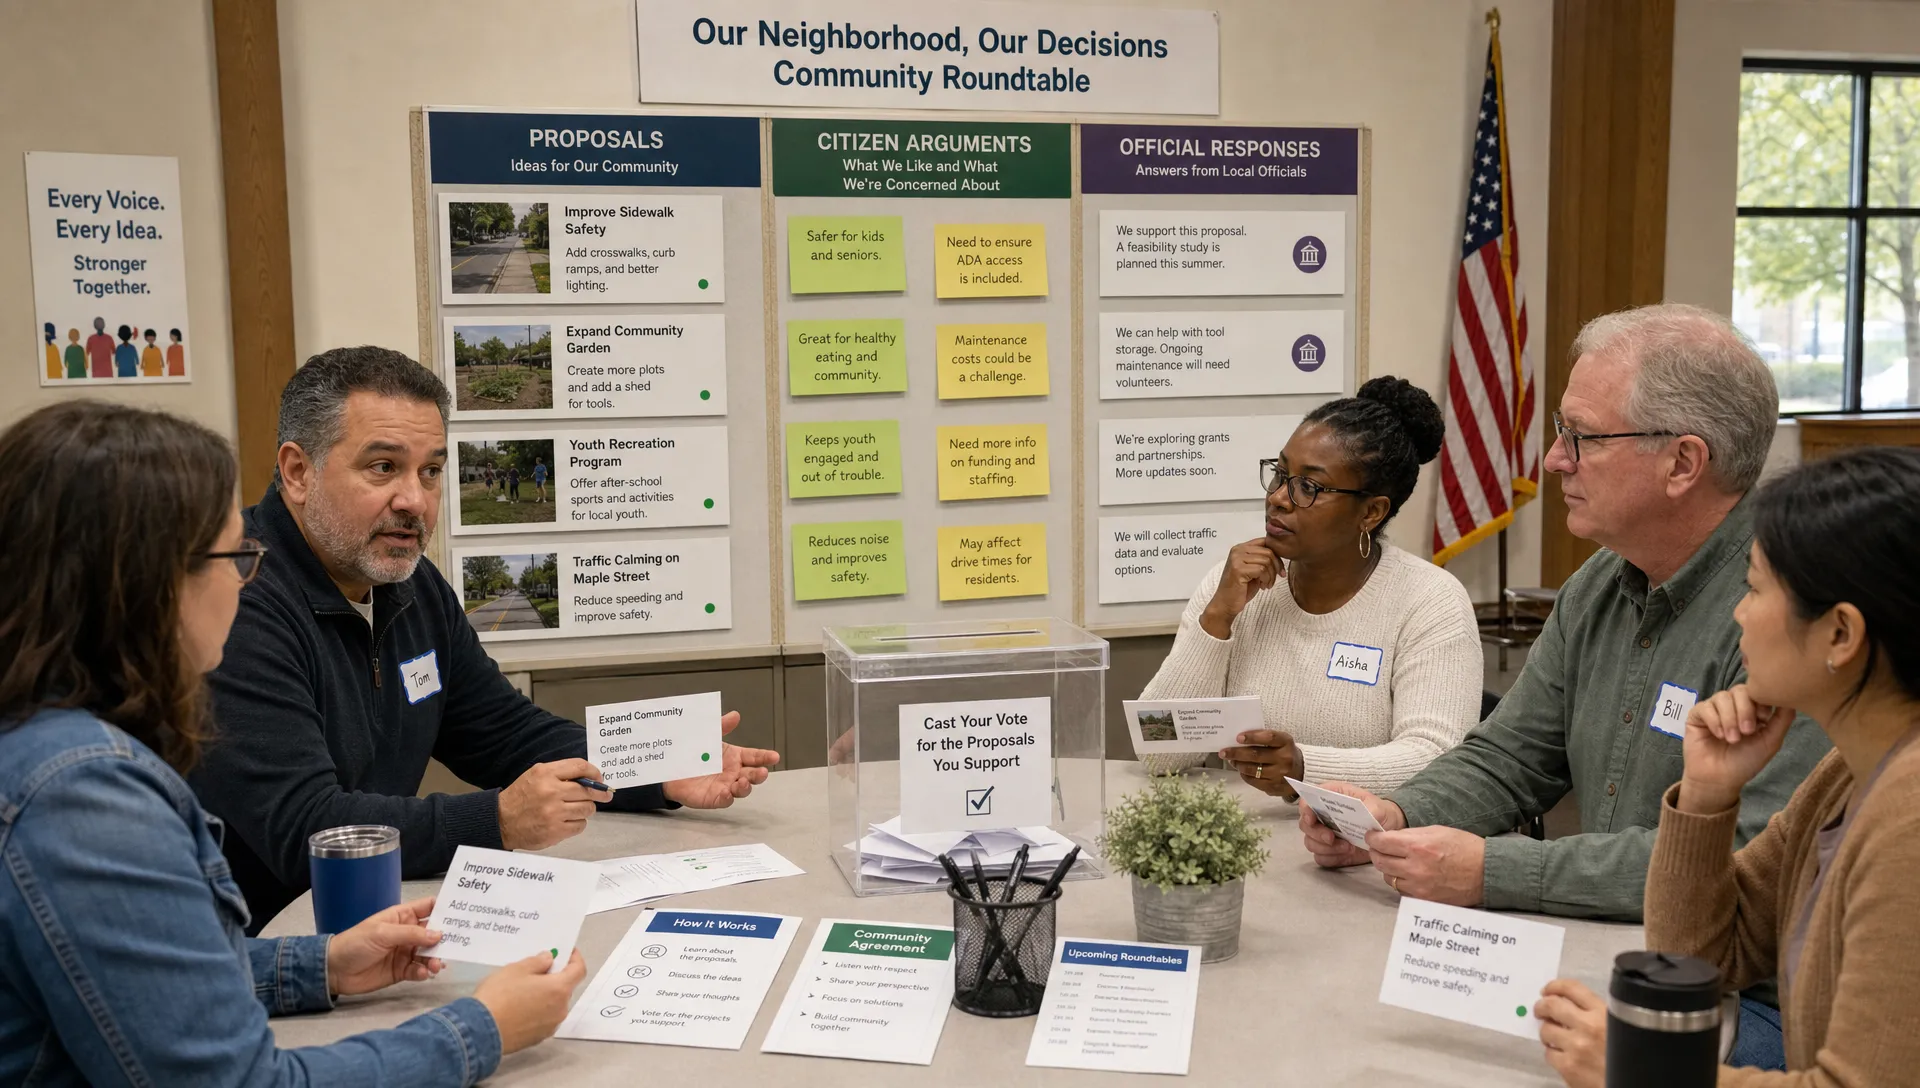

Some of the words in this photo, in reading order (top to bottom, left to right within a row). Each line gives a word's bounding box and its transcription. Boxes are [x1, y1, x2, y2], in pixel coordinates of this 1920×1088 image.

[693, 17, 748, 45] Our
[759, 20, 968, 57] Neighborhood,
[979, 27, 1028, 54] Our
[1038, 29, 1168, 58] Decisions
[774, 60, 933, 95] Community
[943, 65, 1090, 93] Roundtable
[530, 129, 663, 149] PROPOSALS
[818, 132, 898, 151] CITIZEN
[906, 134, 1031, 153] ARGUMENTS
[1120, 138, 1205, 156] OFFICIAL
[1211, 140, 1320, 158] RESPONSES
[511, 159, 547, 172] Ideas
[551, 159, 570, 172] for
[574, 159, 599, 172] Our
[602, 160, 679, 176] Community
[843, 158, 878, 171] What
[882, 159, 903, 171] We
[907, 159, 933, 172] Like
[936, 160, 960, 172] and
[963, 160, 998, 172] What
[1135, 164, 1188, 176] Answers
[1191, 164, 1219, 176] from
[1223, 165, 1254, 177] Local
[1258, 165, 1307, 177] Officials
[843, 177, 882, 190] We're
[886, 178, 957, 191] Concerned
[961, 178, 1000, 191] About
[48, 188, 102, 214] Every
[106, 190, 165, 210] Voice.
[565, 206, 616, 220] Improve
[620, 206, 674, 218] Sidewalk
[56, 219, 111, 244] Every
[117, 220, 162, 240] Idea.
[565, 223, 606, 237] Safety
[807, 230, 839, 242] Safer
[841, 230, 858, 242] for
[862, 230, 885, 242] kids
[1116, 225, 1133, 236] We
[1136, 226, 1176, 238] support
[1179, 225, 1198, 236] this
[1201, 225, 1247, 238] proposal.
[947, 236, 976, 247] Need
[980, 237, 992, 247] to
[995, 239, 1032, 247] ensure
[1116, 242, 1124, 252] A
[1127, 241, 1177, 255] feasibility
[1180, 242, 1209, 255] study
[1212, 242, 1220, 252] is
[565, 247, 587, 258] Add
[590, 247, 650, 259] crosswalks,
[652, 247, 675, 258] curb
[811, 249, 833, 260] and
[837, 249, 881, 260] seniors.
[957, 254, 982, 266] ADA
[986, 257, 1023, 265] access
[74, 254, 147, 275] Stronger
[566, 266, 602, 276] ramps,
[605, 264, 624, 274] and
[628, 264, 659, 274] better
[1116, 258, 1157, 271] planned
[1160, 258, 1179, 269] this
[1182, 260, 1225, 268] summer.
[960, 273, 968, 284] is
[972, 272, 1022, 284] included.
[73, 279, 150, 298] Together.
[566, 280, 608, 293] lighting.
[955, 335, 1027, 346] Maintenance
[952, 354, 981, 364] costs
[985, 352, 1014, 364] could
[1018, 352, 1031, 363] be
[959, 374, 966, 382] a
[970, 370, 1026, 385] challenge.
[805, 435, 839, 448] Keeps
[843, 433, 876, 447] youth
[804, 451, 853, 467] engaged
[857, 450, 879, 462] and
[801, 472, 821, 482] out
[824, 469, 837, 481] of
[840, 468, 884, 481] trouble.
[1114, 532, 1131, 542] We
[1134, 530, 1150, 541] will
[1153, 530, 1186, 540] collect
[1188, 528, 1217, 539] traffic
[1114, 548, 1137, 559] data
[1140, 546, 1159, 558] and
[1161, 545, 1204, 556] evaluate
[573, 555, 611, 567] Traffic
[614, 553, 662, 566] Calming
[665, 553, 679, 563] on
[1114, 564, 1155, 578] options.
[574, 572, 610, 586] Maple
[613, 571, 650, 582] Street
[574, 595, 613, 606] Reduce
[616, 592, 662, 606] speeding
[665, 590, 683, 601] and
[574, 612, 616, 624] improve
[619, 609, 652, 621] safety.
[1335, 655, 1368, 671] Aisha
[410, 671, 430, 688] Tom
[599, 712, 632, 725] Expand
[634, 707, 683, 720] Community
[1663, 699, 1683, 720] Bill
[924, 717, 956, 730] Cast
[960, 715, 992, 727] Your
[996, 713, 1028, 726] Vote
[599, 726, 632, 737] Garden
[600, 744, 628, 754] Create
[629, 742, 651, 750] more
[652, 739, 673, 749] plots
[917, 738, 937, 752] for
[940, 737, 963, 750] the
[967, 732, 1035, 751] Proposals
[601, 757, 617, 768] and
[619, 755, 635, 765] add
[644, 751, 664, 762] shed
[933, 759, 959, 771] You
[964, 755, 1020, 772] Support
[601, 772, 614, 782] for
[616, 768, 638, 779] tools.
[463, 861, 505, 876] Improve
[506, 867, 554, 882] Sidewalk
[457, 877, 492, 893] Safety
[673, 919, 703, 927] How
[704, 920, 715, 928] It
[718, 920, 756, 931] Works
[1414, 915, 1449, 932] Traffic
[1452, 923, 1499, 944] Calming
[1502, 936, 1516, 945] on
[854, 930, 932, 944] Community
[1409, 932, 1443, 948] Maple
[1445, 939, 1480, 956] Street
[849, 940, 926, 953] Agreement
[1068, 949, 1118, 961] Upcoming
[1120, 952, 1182, 964] Roundtables
[668, 971, 701, 979] Discuss
[877, 982, 929, 991] perspective
[822, 994, 848, 1002] Focus
[864, 999, 903, 1007] solutions
